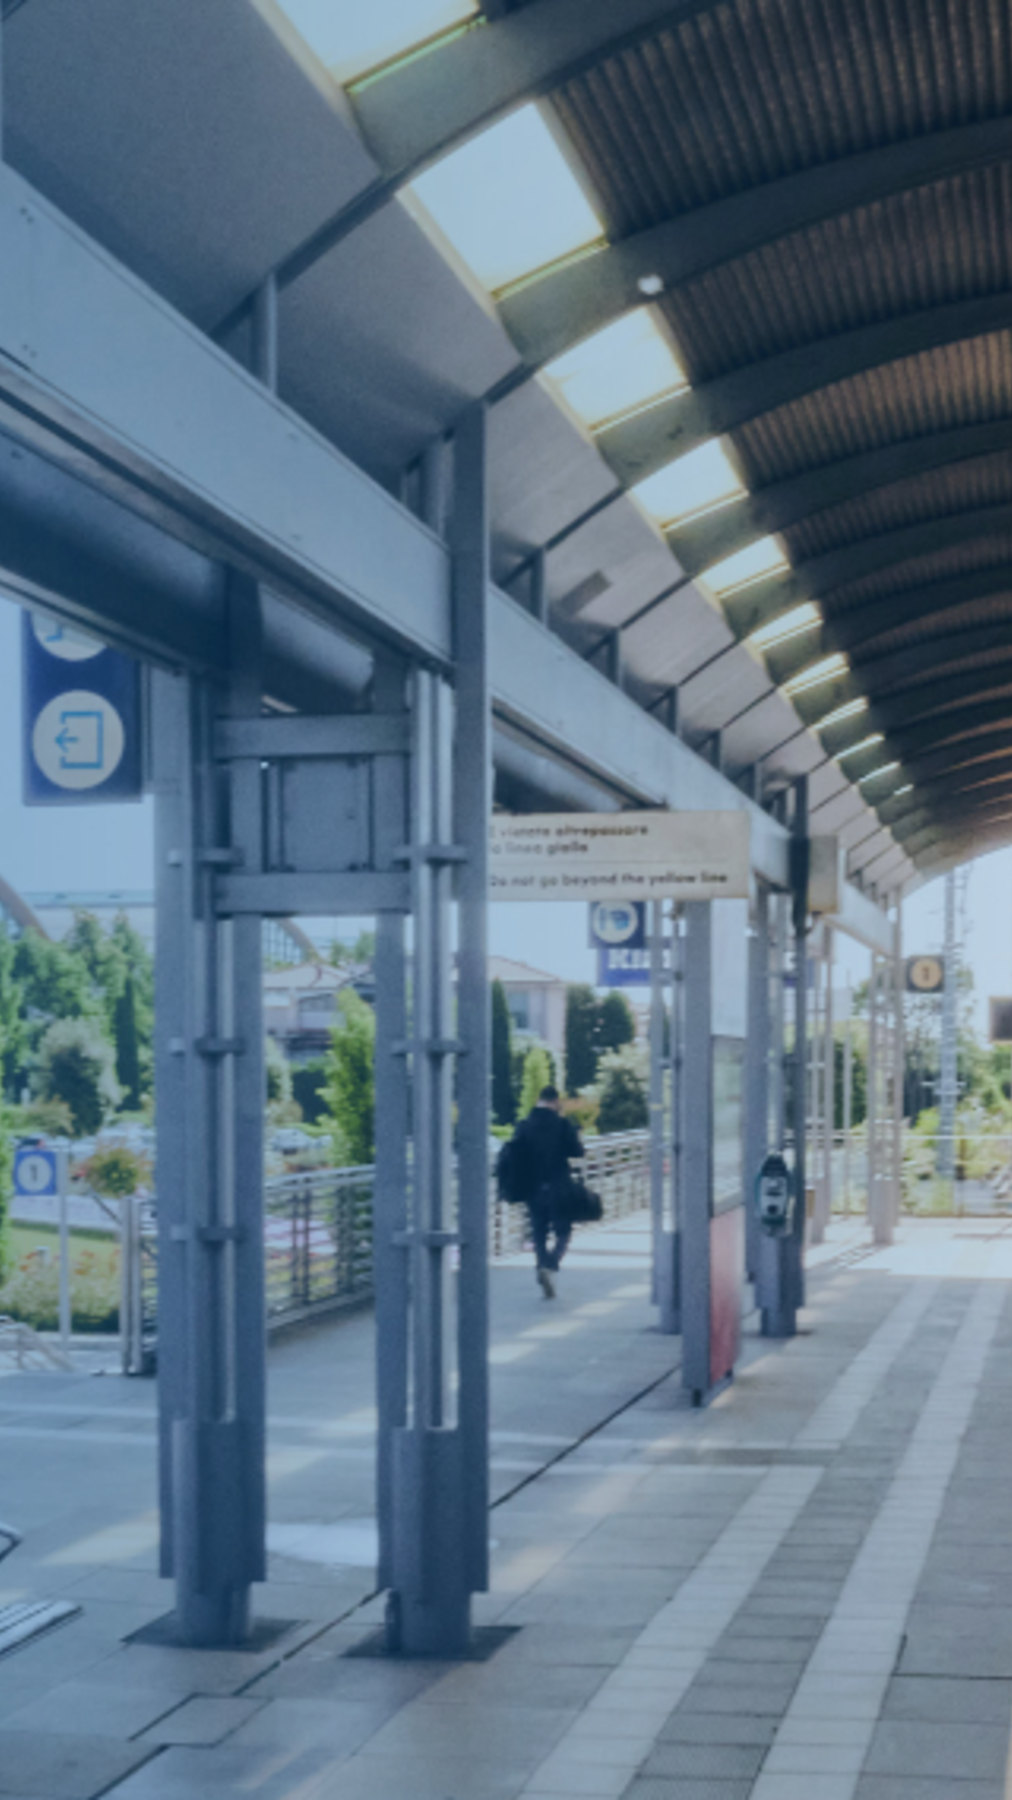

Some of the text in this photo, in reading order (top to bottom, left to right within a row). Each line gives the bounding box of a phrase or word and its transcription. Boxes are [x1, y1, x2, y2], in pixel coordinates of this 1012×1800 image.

[511, 874, 534, 886] not
[539, 875, 558, 889] go
[561, 872, 617, 888] beyond
[621, 872, 644, 883] the
[648, 870, 696, 887] yellow
[700, 870, 728, 883] line
[29, 1163, 38, 1181] 1
